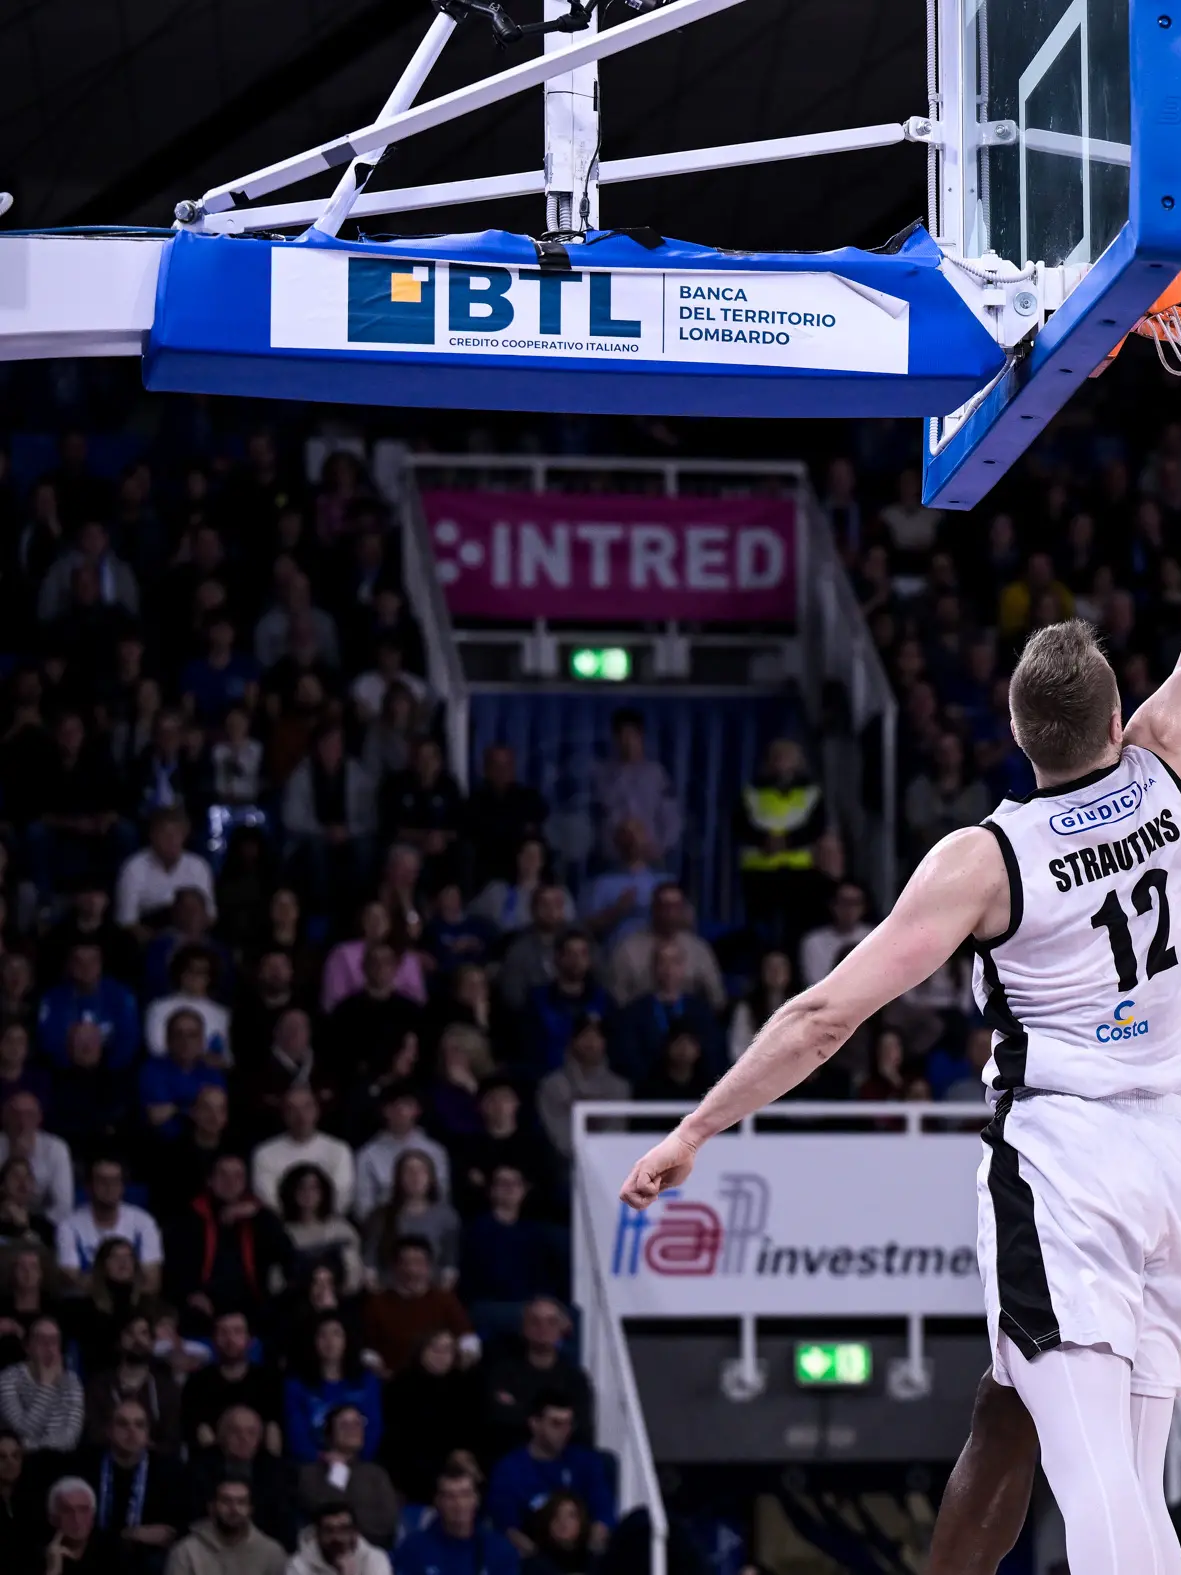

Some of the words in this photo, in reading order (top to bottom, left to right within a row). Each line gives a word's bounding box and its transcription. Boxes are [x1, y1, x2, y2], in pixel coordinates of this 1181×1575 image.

[449, 262, 641, 338] BTL
[680, 286, 747, 301] BANCA
[679, 306, 715, 321] DEL
[720, 308, 836, 327] TERRITORIO
[449, 338, 499, 348] CREDITO
[502, 340, 583, 350] COOPERATIVO
[586, 342, 639, 353] ITALIANO
[679, 327, 790, 345] LOMBARDO
[491, 522, 785, 589] INTRED
[1049, 808, 1180, 893] STRAUTINS
[1090, 868, 1179, 992] 12
[1096, 1018, 1149, 1043] Costa
